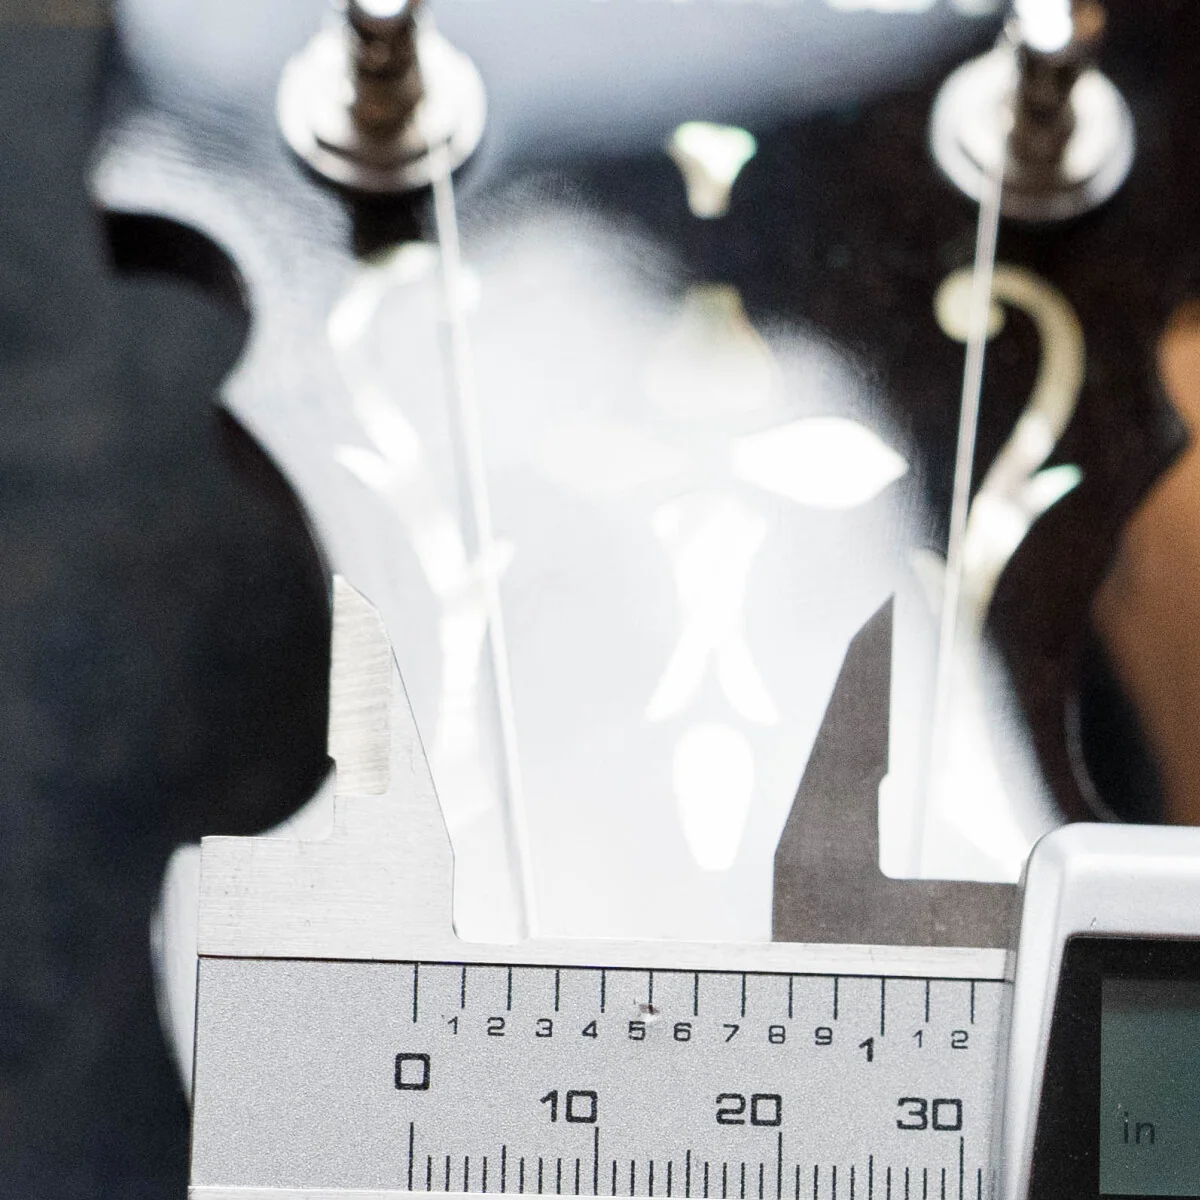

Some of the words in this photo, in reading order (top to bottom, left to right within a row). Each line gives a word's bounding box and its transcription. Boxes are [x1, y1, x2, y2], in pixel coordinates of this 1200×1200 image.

[447, 1015, 458, 1035] 1
[486, 1016, 506, 1037] 2
[535, 1017, 554, 1038] 3
[581, 1019, 599, 1040] 4
[628, 1020, 646, 1041] 5
[673, 1021, 692, 1042] 6
[722, 1023, 740, 1043] 7
[767, 1024, 787, 1045] 8
[814, 1026, 833, 1046] 9
[858, 1036, 875, 1062] 1
[912, 1029, 923, 1049] 1
[950, 1029, 969, 1050] 2
[395, 1052, 431, 1091] 0
[540, 1089, 598, 1123] 10
[715, 1092, 782, 1126] 20
[896, 1097, 962, 1131] 30
[1123, 1111, 1156, 1145] in
